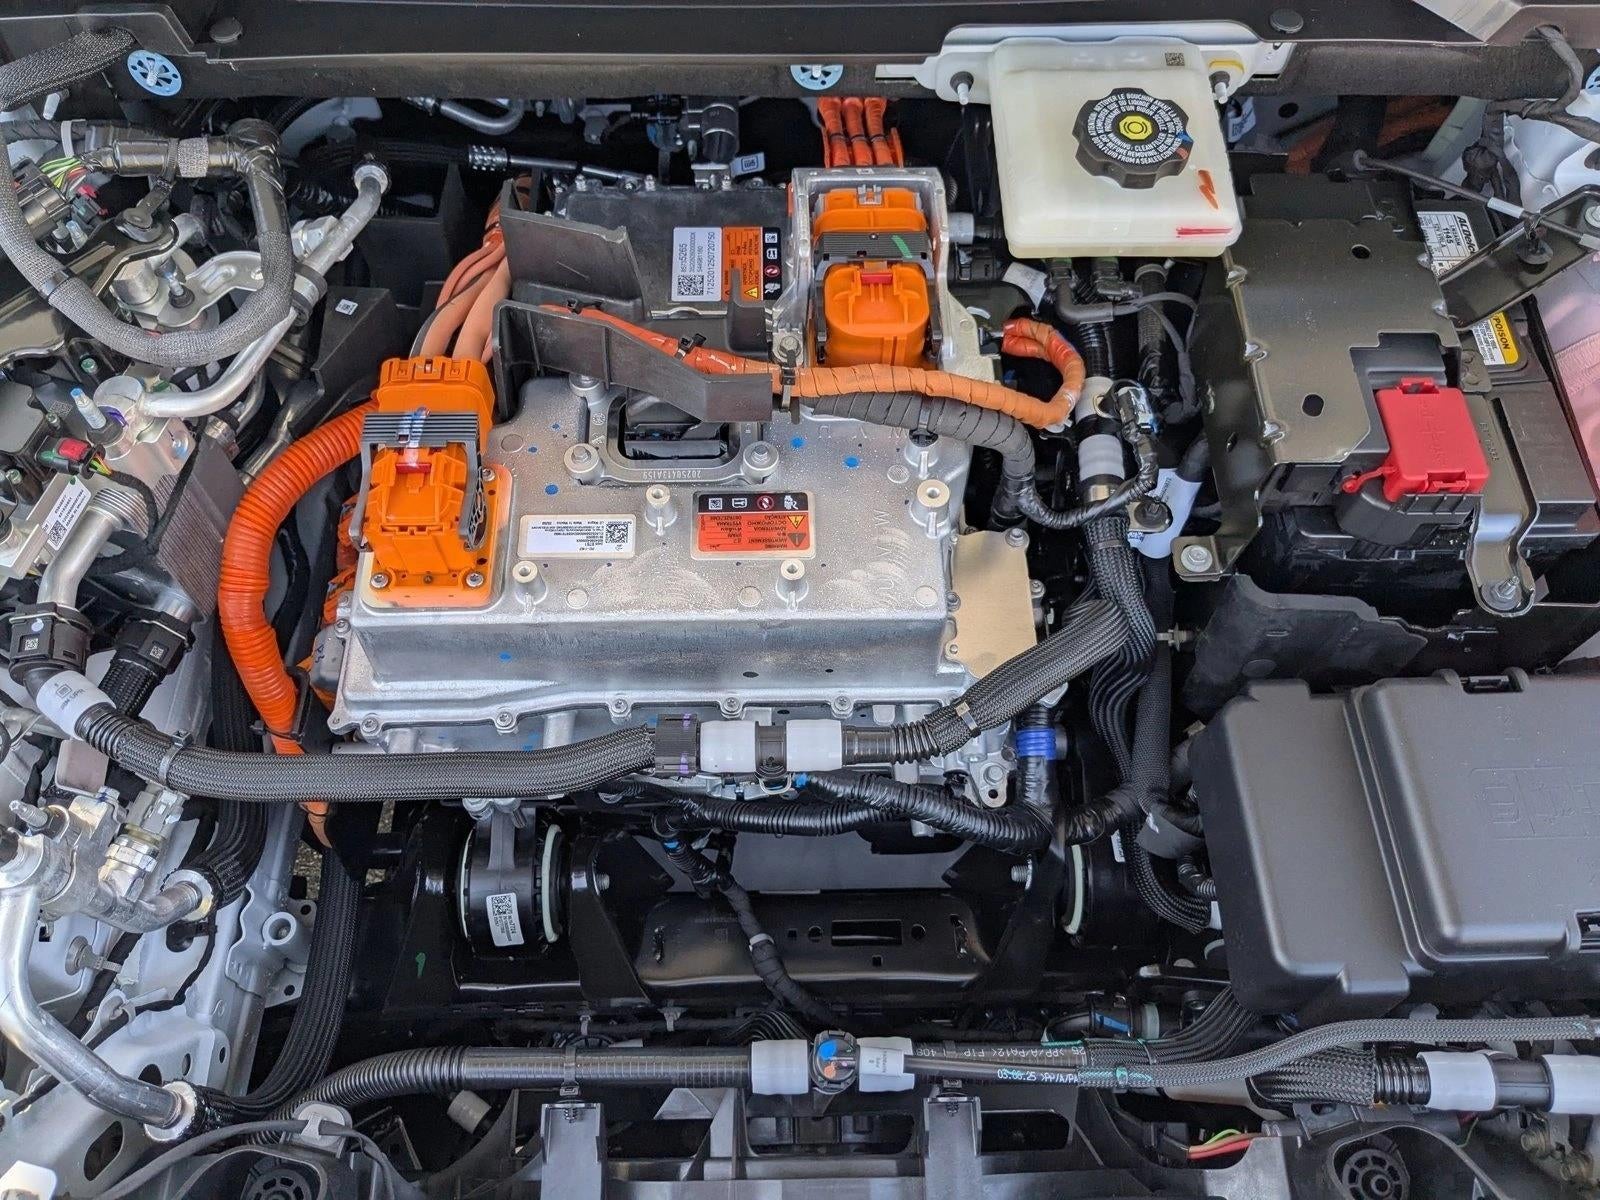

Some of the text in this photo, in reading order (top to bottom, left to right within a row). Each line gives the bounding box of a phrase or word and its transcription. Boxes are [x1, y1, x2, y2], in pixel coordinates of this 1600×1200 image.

[1094, 95, 1118, 111] NETTOYER
[1126, 93, 1154, 102] BOUCHON
[1154, 99, 1171, 112] AVANT
[1106, 102, 1118, 110] QUE
[1128, 100, 1150, 108] LIQUIDE
[1157, 110, 1171, 122] FREIN
[1100, 134, 1110, 143] CAP
[1106, 141, 1129, 155] BEFORE
[1158, 144, 1168, 153] USE
[1134, 144, 1154, 152] CLEAN
[1152, 132, 1167, 148] FILLER
[1101, 146, 1119, 158] FLUID
[1118, 152, 1135, 164] FROM
[1140, 155, 1160, 164] SEALED
[1443, 228, 1453, 244] 1145
[1493, 315, 1510, 349] POISON
